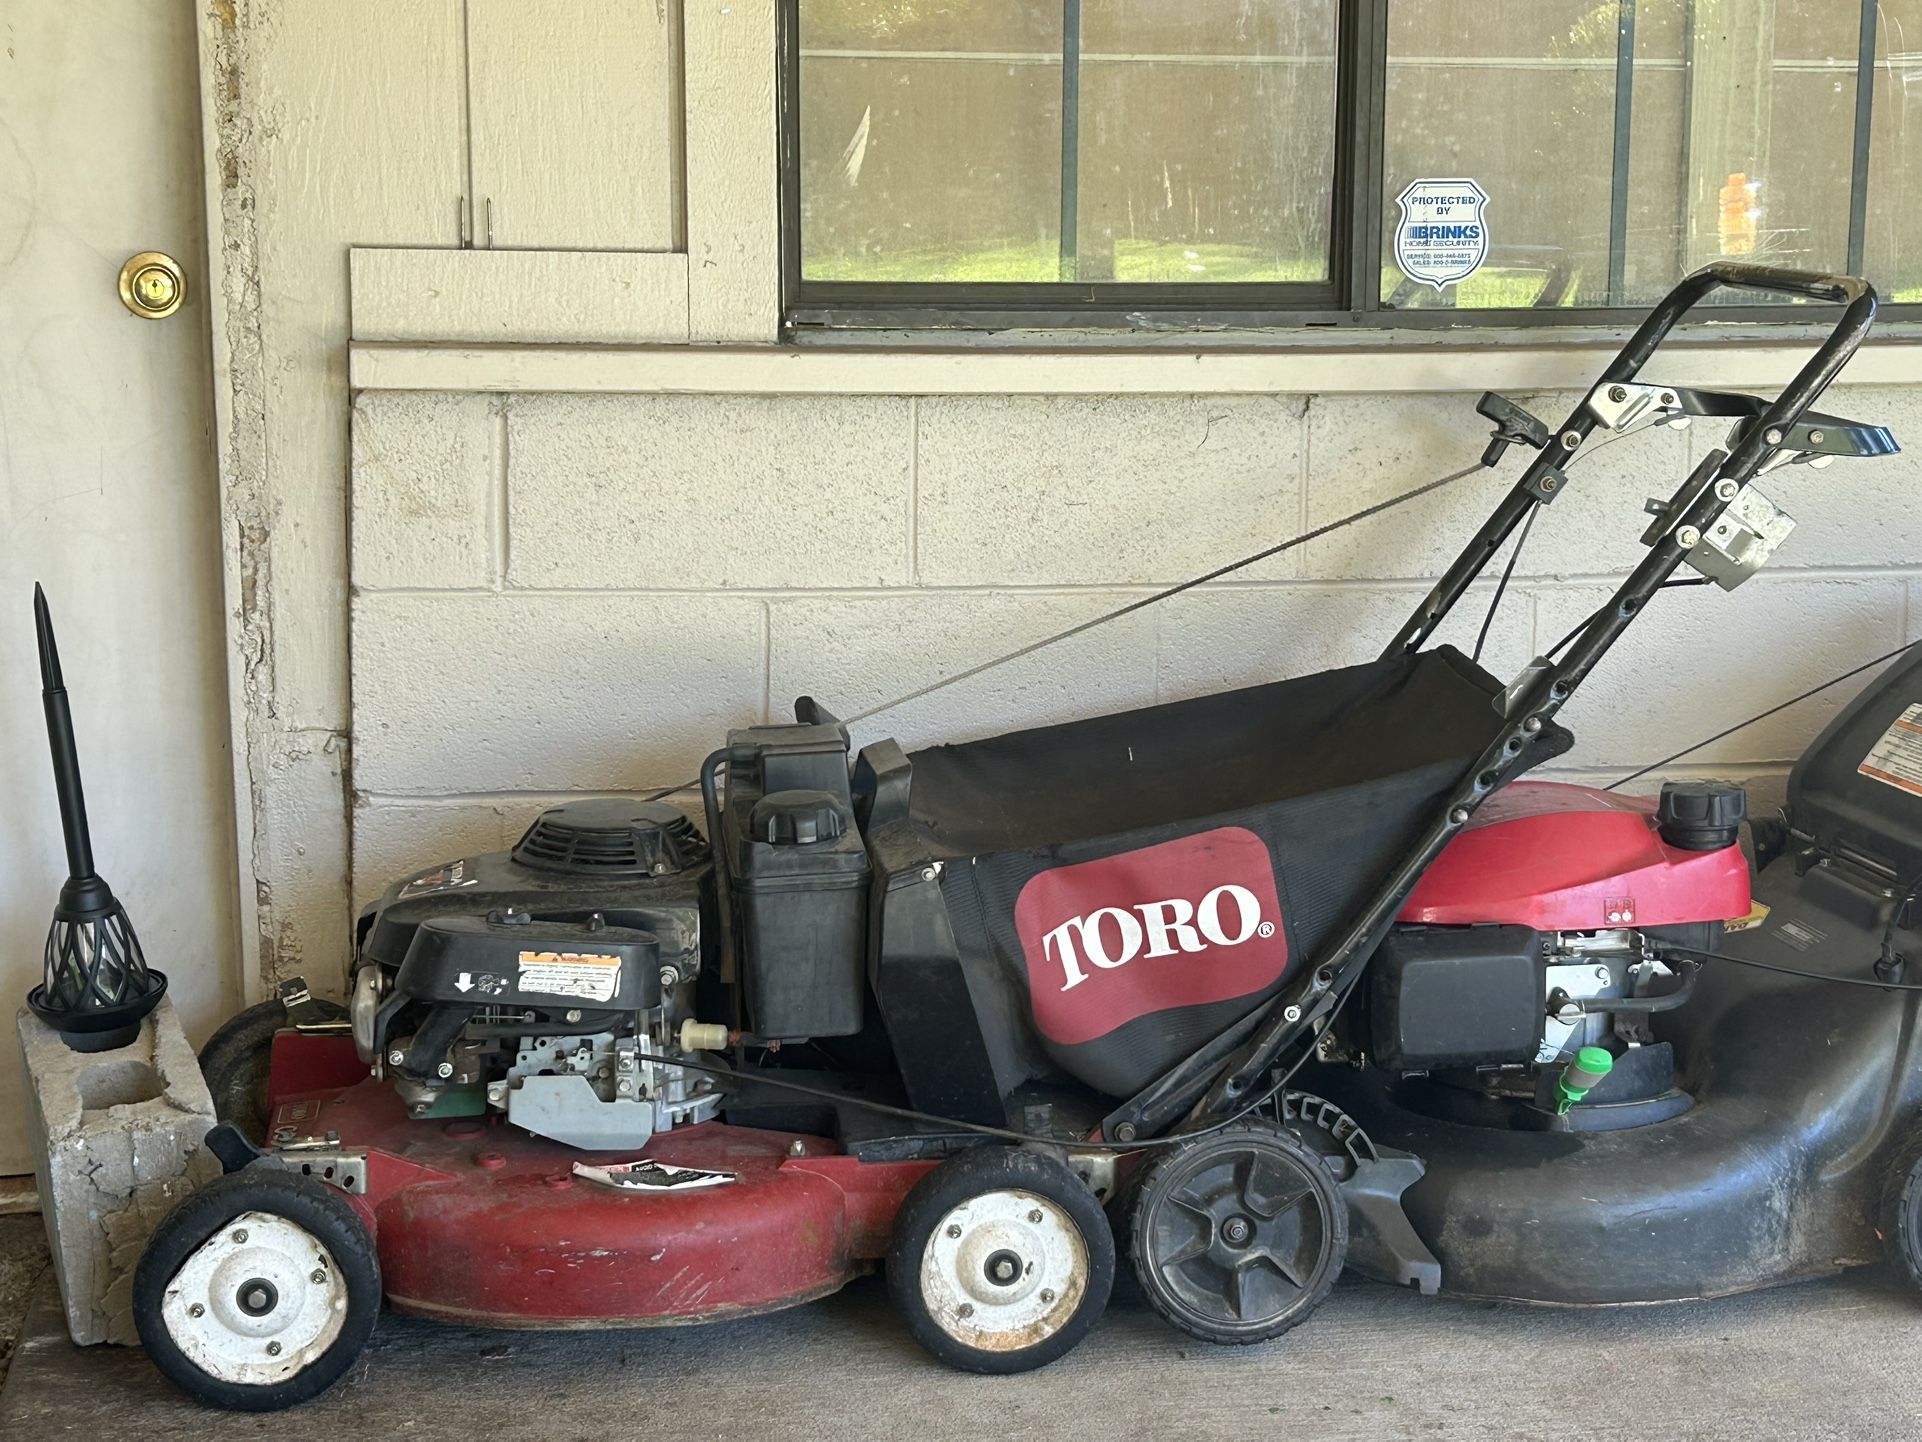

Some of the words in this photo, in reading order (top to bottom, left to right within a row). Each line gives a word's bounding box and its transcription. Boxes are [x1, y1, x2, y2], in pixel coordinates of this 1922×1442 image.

[1411, 196, 1476, 205] PROTECTED
[1436, 206, 1451, 215] BY
[1417, 225, 1480, 239] BRINKS
